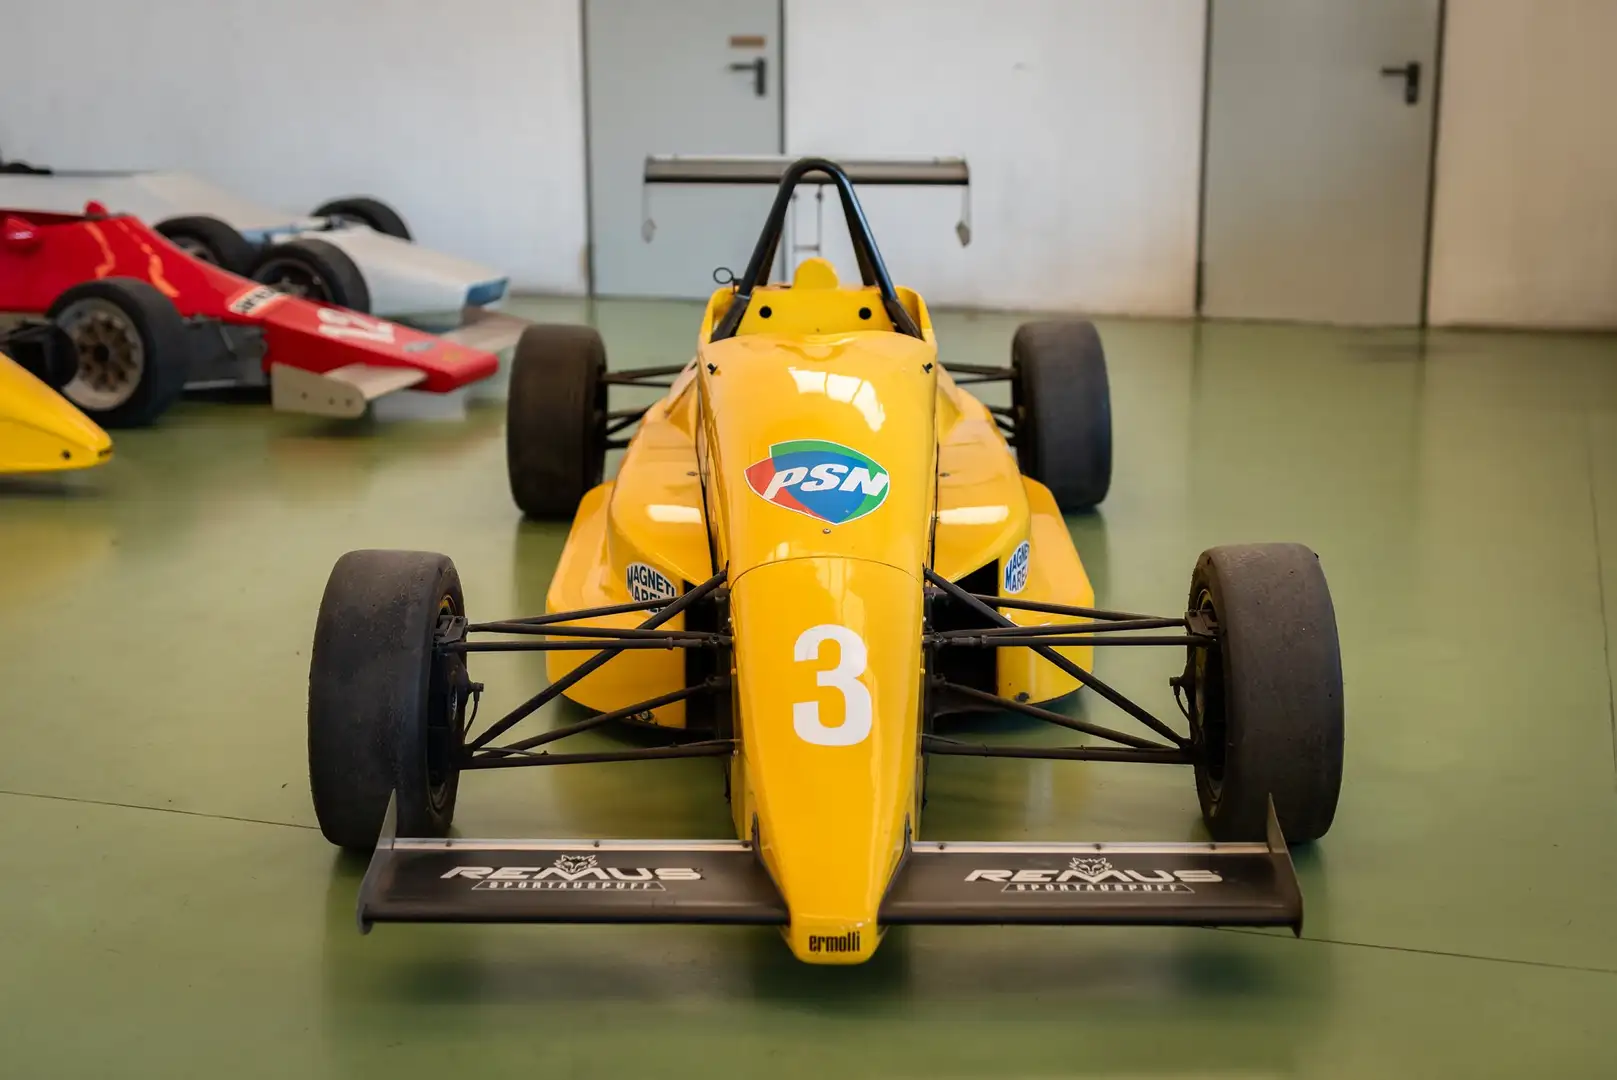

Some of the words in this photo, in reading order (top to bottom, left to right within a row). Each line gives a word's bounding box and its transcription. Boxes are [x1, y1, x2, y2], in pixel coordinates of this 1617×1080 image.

[762, 463, 889, 500] PSN
[1005, 543, 1030, 578] MAGNE
[627, 565, 675, 597] MAGNETI
[793, 623, 873, 747] 3
[440, 866, 702, 882] REMUS
[964, 869, 1223, 884] REMUS
[488, 881, 652, 890] SPORTAUSPUFF
[1015, 883, 1177, 892] SPORTAUSPUFF
[808, 931, 860, 953] ermolli
